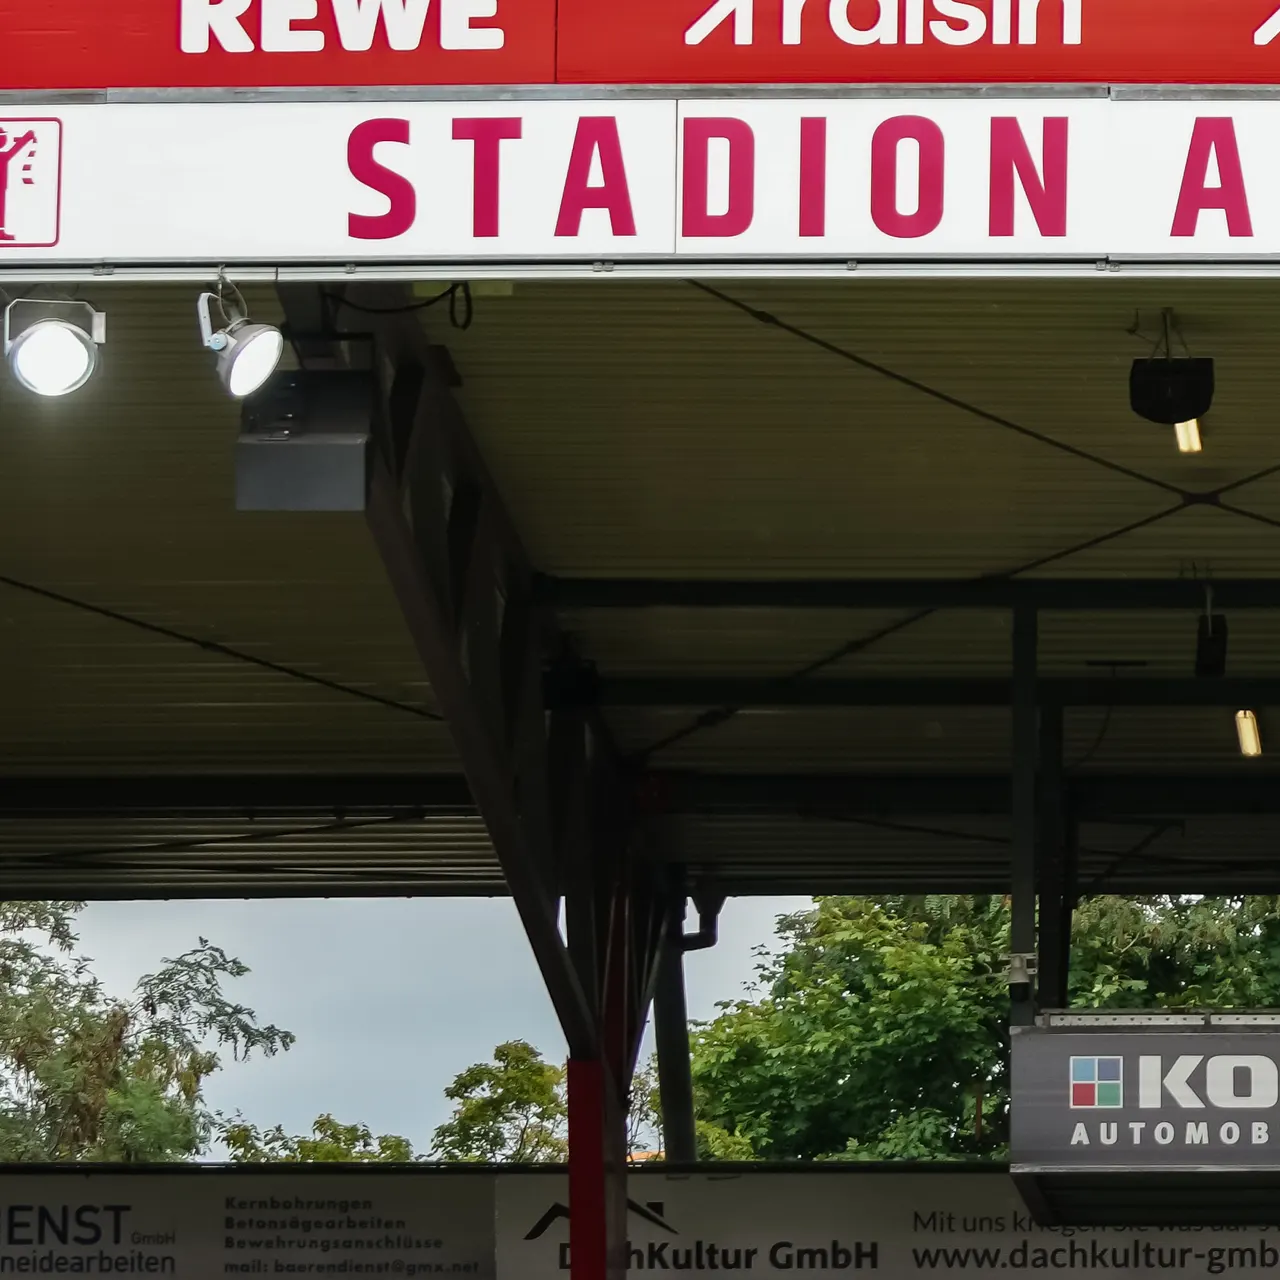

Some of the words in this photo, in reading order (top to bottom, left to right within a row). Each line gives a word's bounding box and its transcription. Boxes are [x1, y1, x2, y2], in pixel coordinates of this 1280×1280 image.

[181, 0, 505, 53] REWE
[347, 115, 1069, 240] STADION
[224, 1196, 374, 1215] Kernbohrungen
[224, 1215, 407, 1234] Betonsägearbeiten
[912, 1210, 957, 1234] Mit
[961, 1216, 1006, 1234] uns
[131, 1231, 176, 1247] GmbH
[224, 1234, 445, 1254] Bewehrungsanschlüsse
[768, 1240, 879, 1270] GmbH
[224, 1259, 270, 1274] mail:
[274, 1258, 480, 1278] baerendienst@gmx.net
